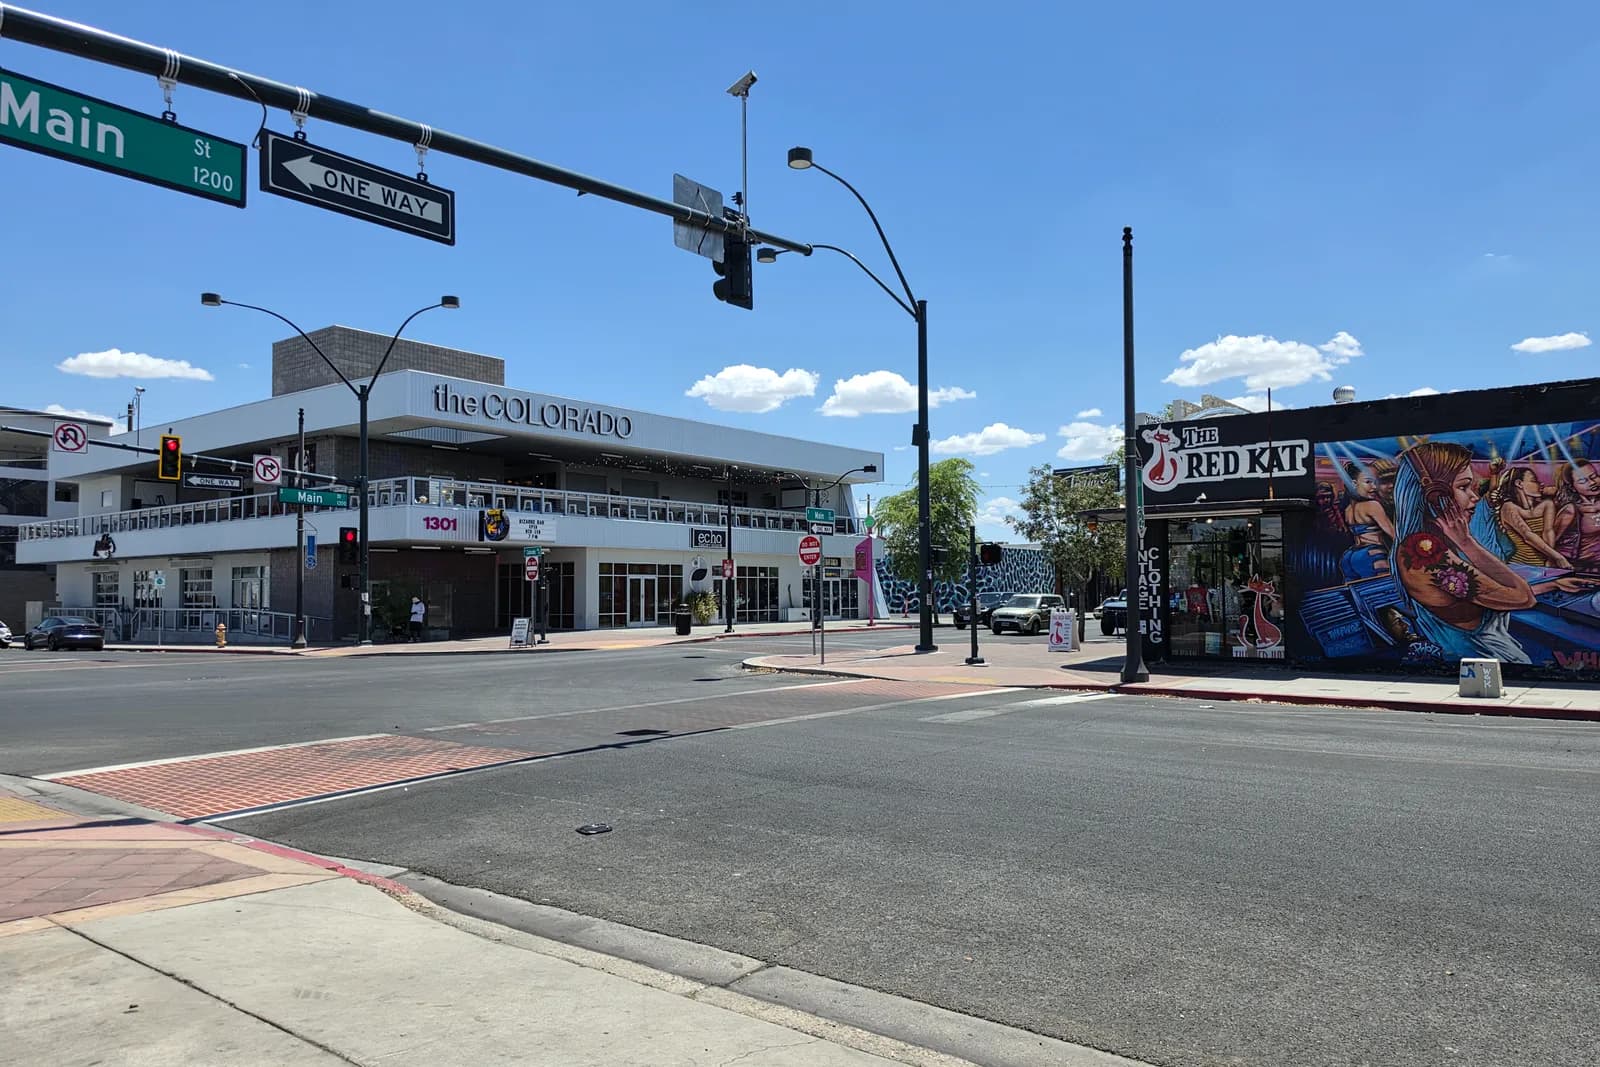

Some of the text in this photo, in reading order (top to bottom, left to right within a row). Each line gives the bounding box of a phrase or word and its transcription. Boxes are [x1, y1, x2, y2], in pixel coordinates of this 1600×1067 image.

[0, 82, 212, 159] Main St
[193, 166, 233, 192] 1200
[323, 170, 430, 217] ONE WAY
[483, 391, 633, 439] COLORADO
[1183, 428, 1217, 446] THE
[1185, 444, 1305, 479] RED KAT
[219, 479, 235, 487] WAY
[298, 491, 323, 504] Main
[423, 516, 457, 531] 1301
[698, 530, 722, 544] echo
[1137, 527, 1148, 610] VINTAGE
[1148, 547, 1162, 644] CLOTHING
